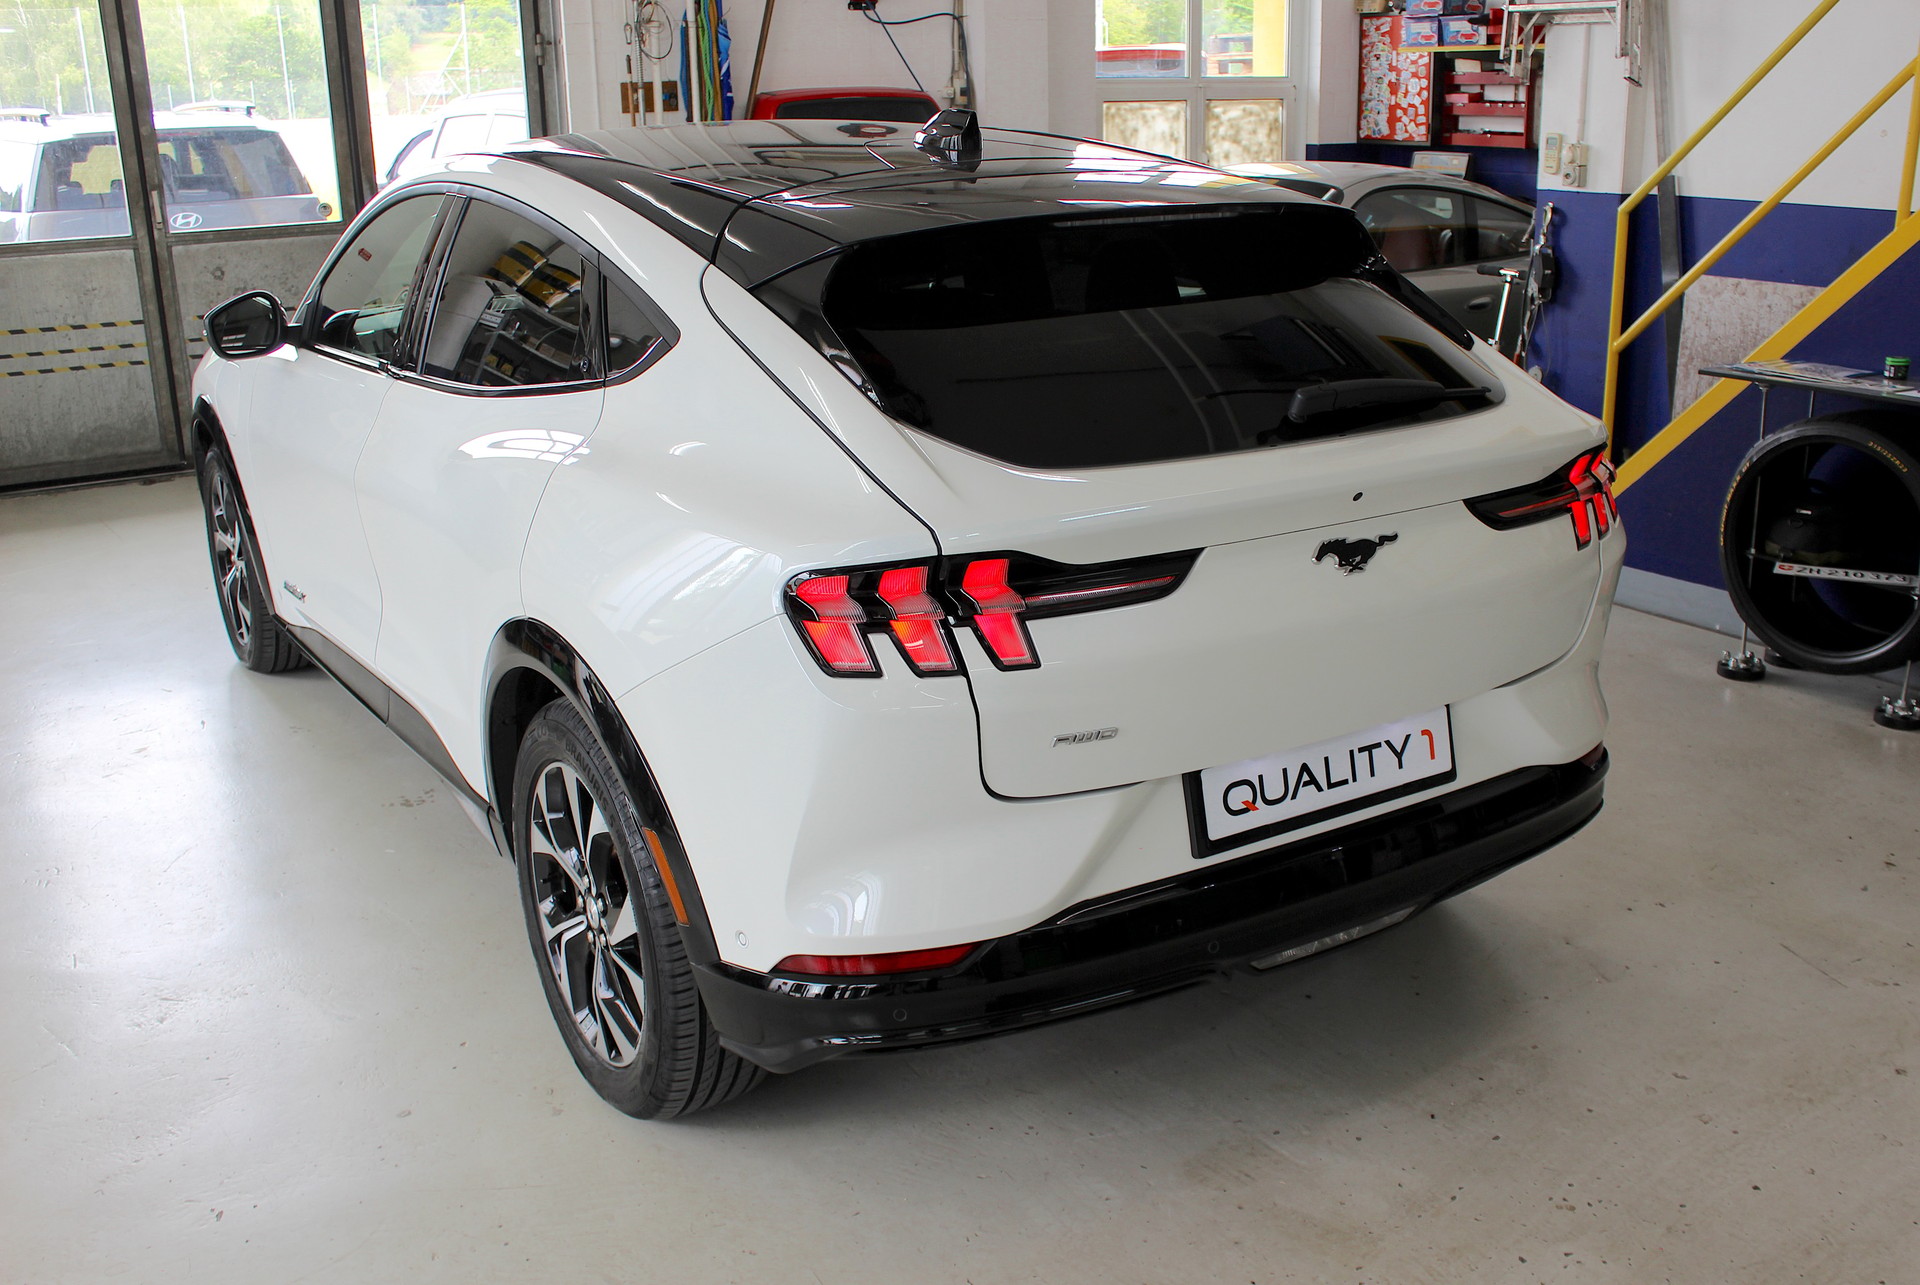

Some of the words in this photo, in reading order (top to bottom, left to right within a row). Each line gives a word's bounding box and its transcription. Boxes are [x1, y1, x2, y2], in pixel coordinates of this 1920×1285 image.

[1796, 566, 1820, 575] ZH
[1828, 569, 1865, 579] 210
[1052, 726, 1119, 748] AWD
[566, 741, 609, 810] BRAVURIS
[1222, 733, 1412, 817] QUALITY
[1420, 728, 1436, 761] 1
